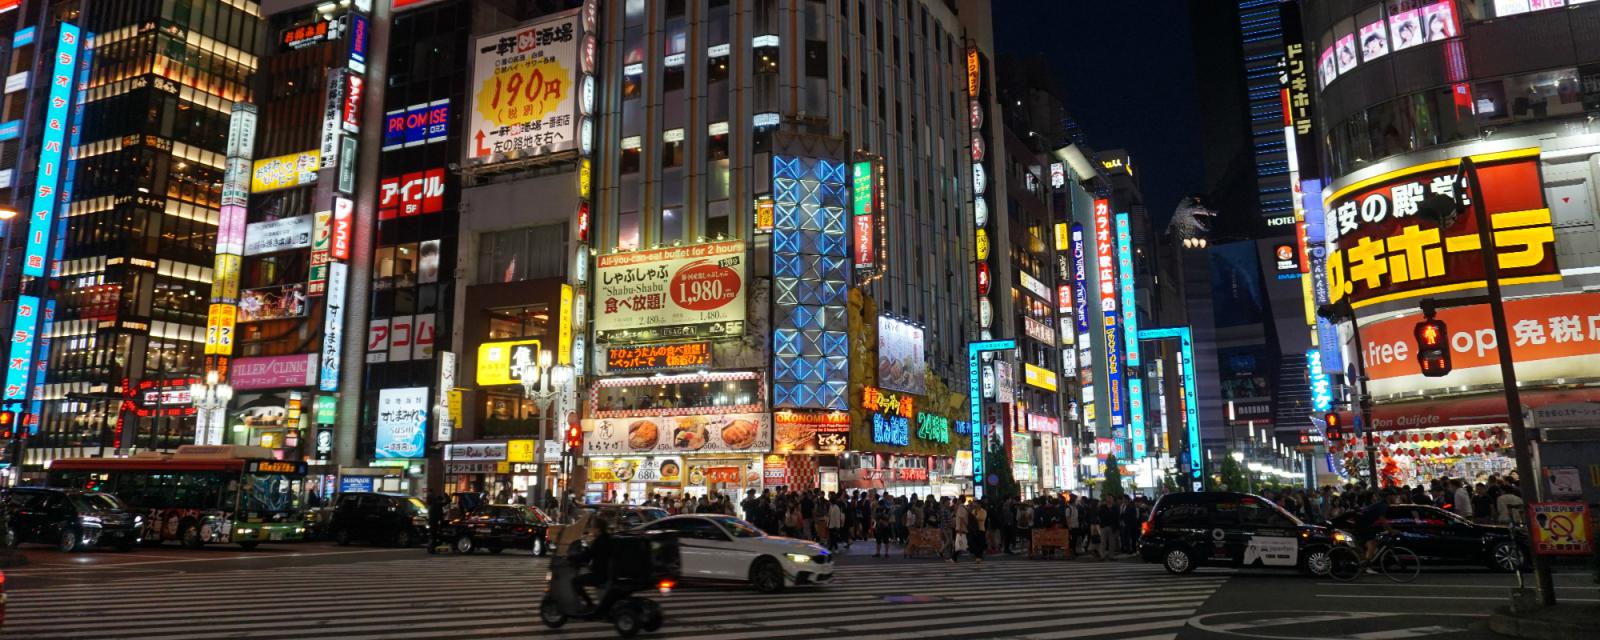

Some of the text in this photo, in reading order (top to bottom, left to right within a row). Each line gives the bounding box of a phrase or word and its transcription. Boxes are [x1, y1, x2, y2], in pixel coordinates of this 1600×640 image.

[480, 22, 573, 56] 一軒め酒場
[491, 68, 561, 109] 190円
[389, 108, 447, 132] PROMISE
[28, 31, 75, 269] カラオケ&パーティー館
[494, 131, 564, 154] 左の路地を右へ
[381, 175, 445, 204] アイフル
[406, 205, 416, 214] 5F
[601, 243, 742, 265] All-you-can-eat buffet for 2 hours
[1096, 203, 1113, 294] カラオケ歌広場
[603, 265, 669, 285] しゃぶしゃぶ
[680, 279, 723, 304] 1,980
[369, 320, 434, 350] アコム
[663, 327, 696, 337] USAGA
[7, 305, 31, 397] カラオケ
[1369, 339, 1408, 368] Free
[777, 414, 824, 423] OKONOMI
[970, 362, 981, 463] GODZILLA ROAD
[1371, 414, 1440, 428] Don Quijote
[638, 470, 655, 480] 680
